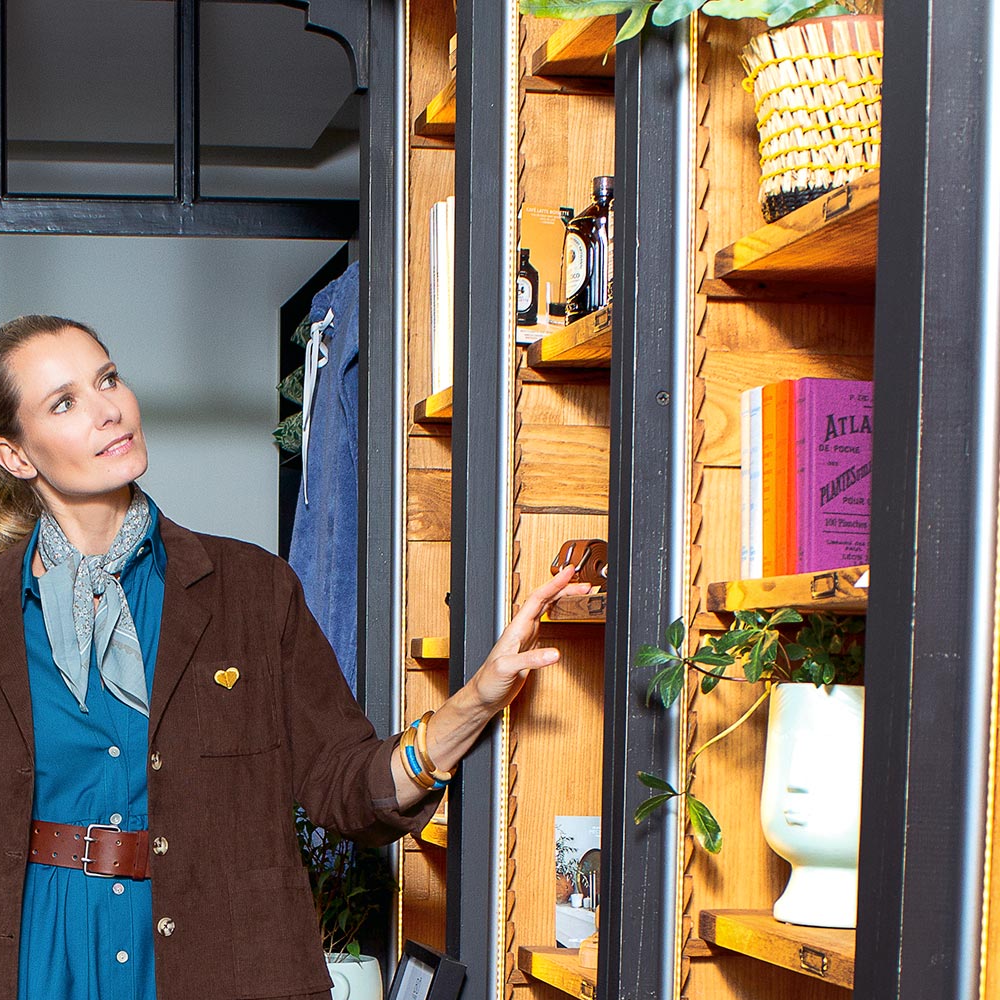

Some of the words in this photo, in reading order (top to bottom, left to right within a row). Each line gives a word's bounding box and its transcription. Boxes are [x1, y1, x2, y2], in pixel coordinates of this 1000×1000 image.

[823, 413, 873, 443] ATLA
[819, 444, 830, 452] DE
[834, 445, 861, 454] POCHE
[820, 465, 856, 507] PLANTES
